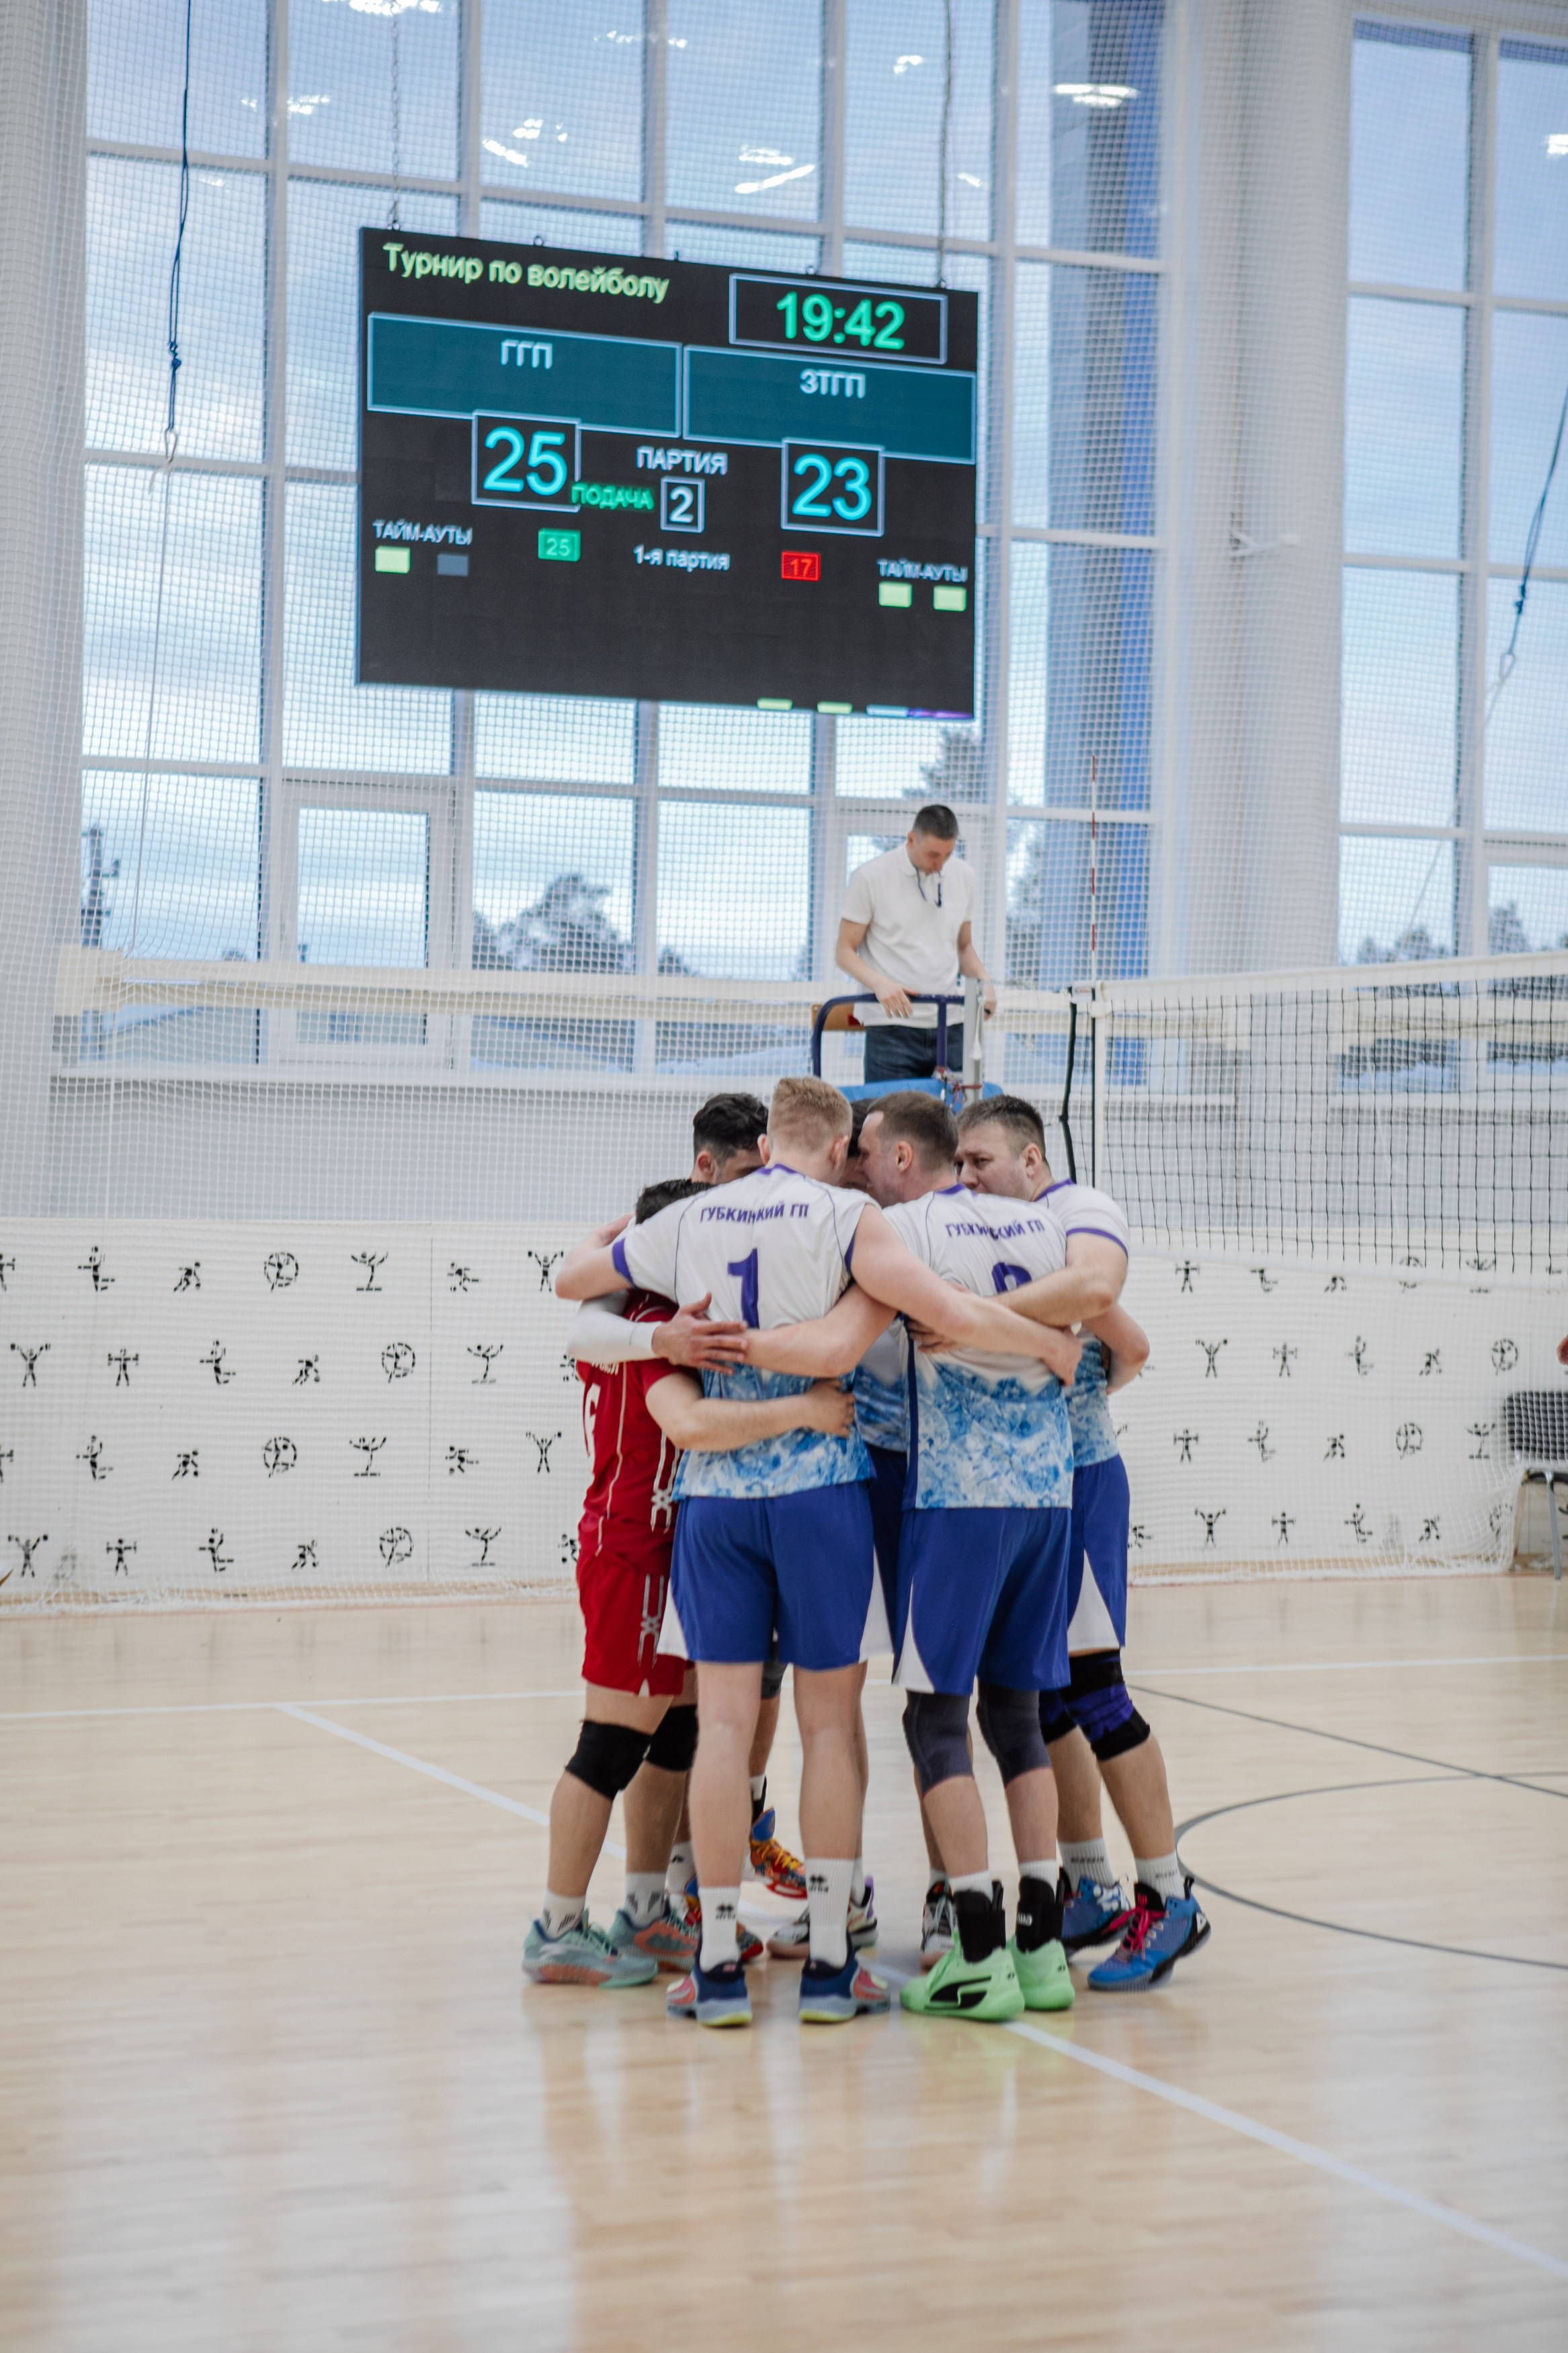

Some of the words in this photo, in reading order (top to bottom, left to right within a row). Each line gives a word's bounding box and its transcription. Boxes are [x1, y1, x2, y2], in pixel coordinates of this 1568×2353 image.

[383, 242, 483, 284] Турнир
[489, 260, 522, 284] по
[527, 264, 669, 303] волейболу
[777, 292, 905, 350] 19:42
[483, 426, 567, 496] 25
[636, 446, 728, 475] ПАРТИЯ
[571, 483, 654, 510] ПОДАЧА
[792, 454, 872, 520] 23
[669, 486, 694, 523] 2
[373, 520, 472, 545] ТАЙМ-АУТЫ
[546, 539, 570, 557] 25
[634, 544, 663, 565] 1-я
[665, 549, 731, 572] партия
[791, 559, 812, 577] 17
[877, 559, 968, 582] ТАЙМ-АУТЫ
[790, 1203, 810, 1218] ГП
[1027, 1220, 1045, 1233] ГП
[727, 1248, 759, 1329] 1
